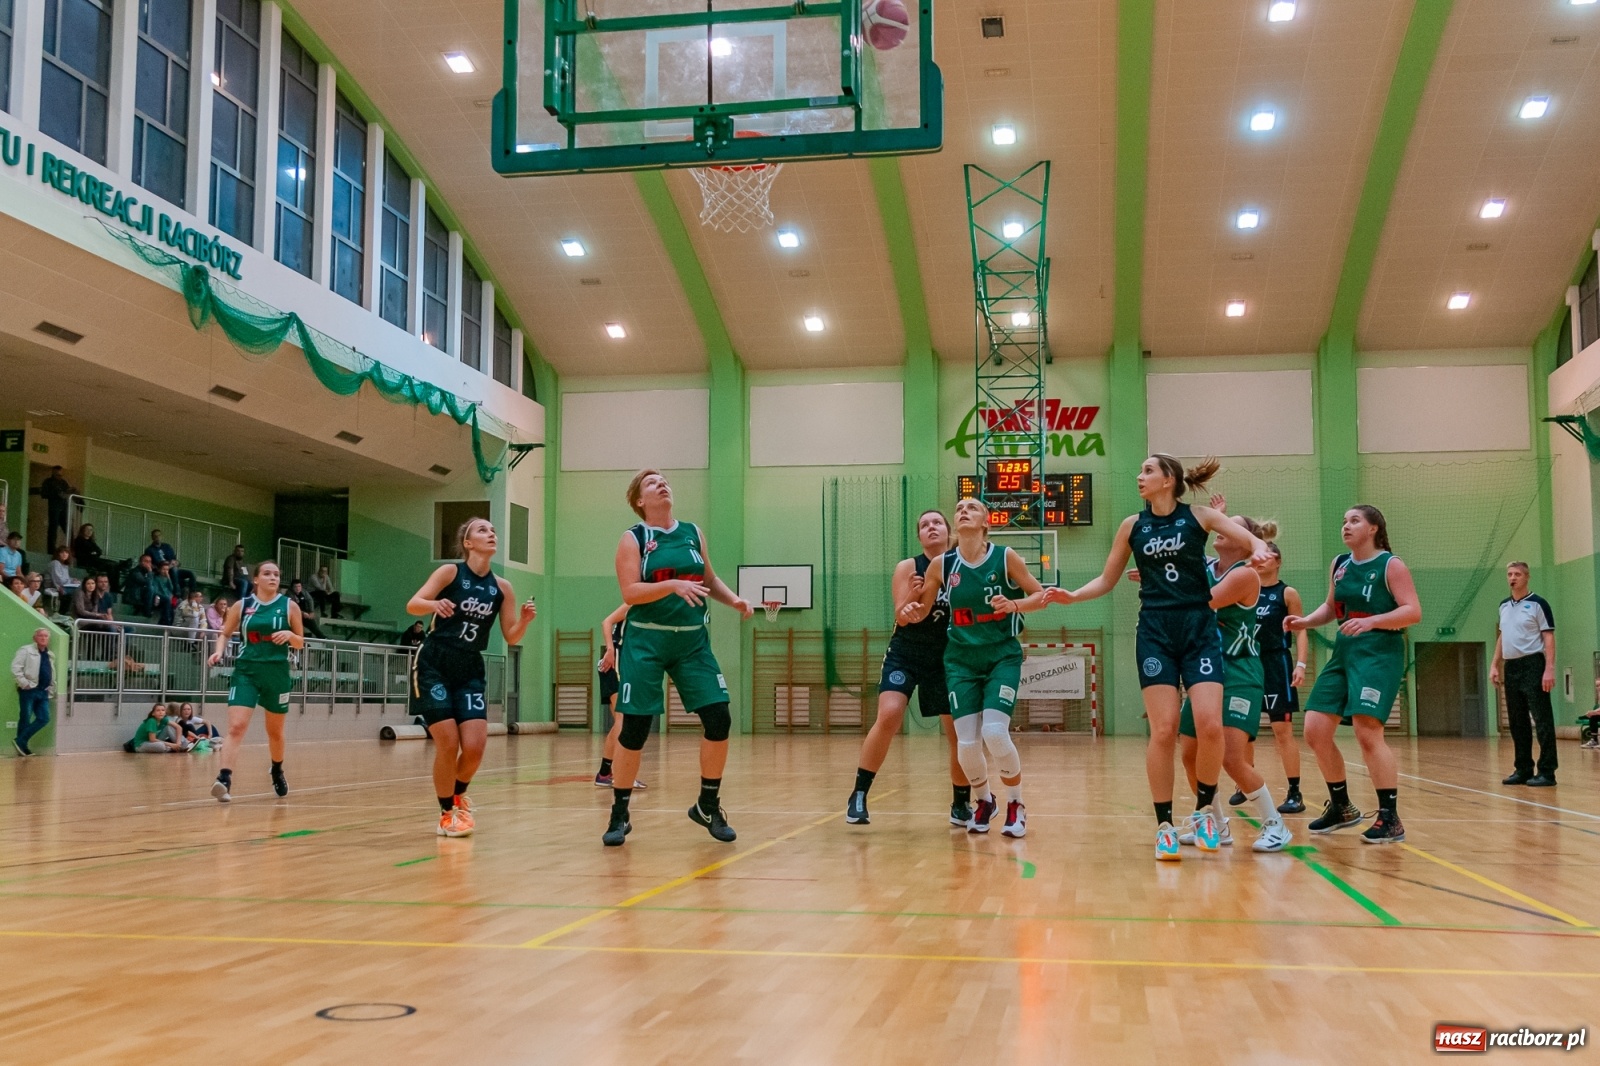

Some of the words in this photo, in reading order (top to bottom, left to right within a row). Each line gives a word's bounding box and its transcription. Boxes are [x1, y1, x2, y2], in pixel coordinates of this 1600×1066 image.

[27, 143, 35, 175] I
[41, 151, 153, 235] REKREACJI
[159, 212, 243, 281] RACIBÓRZ
[6, 437, 18, 449] F
[1164, 562, 1179, 582] 8
[1361, 584, 1373, 602] 4
[458, 621, 480, 641] 13
[1199, 657, 1213, 675] 8
[465, 693, 485, 710] 13
[1263, 694, 1279, 710] 17
